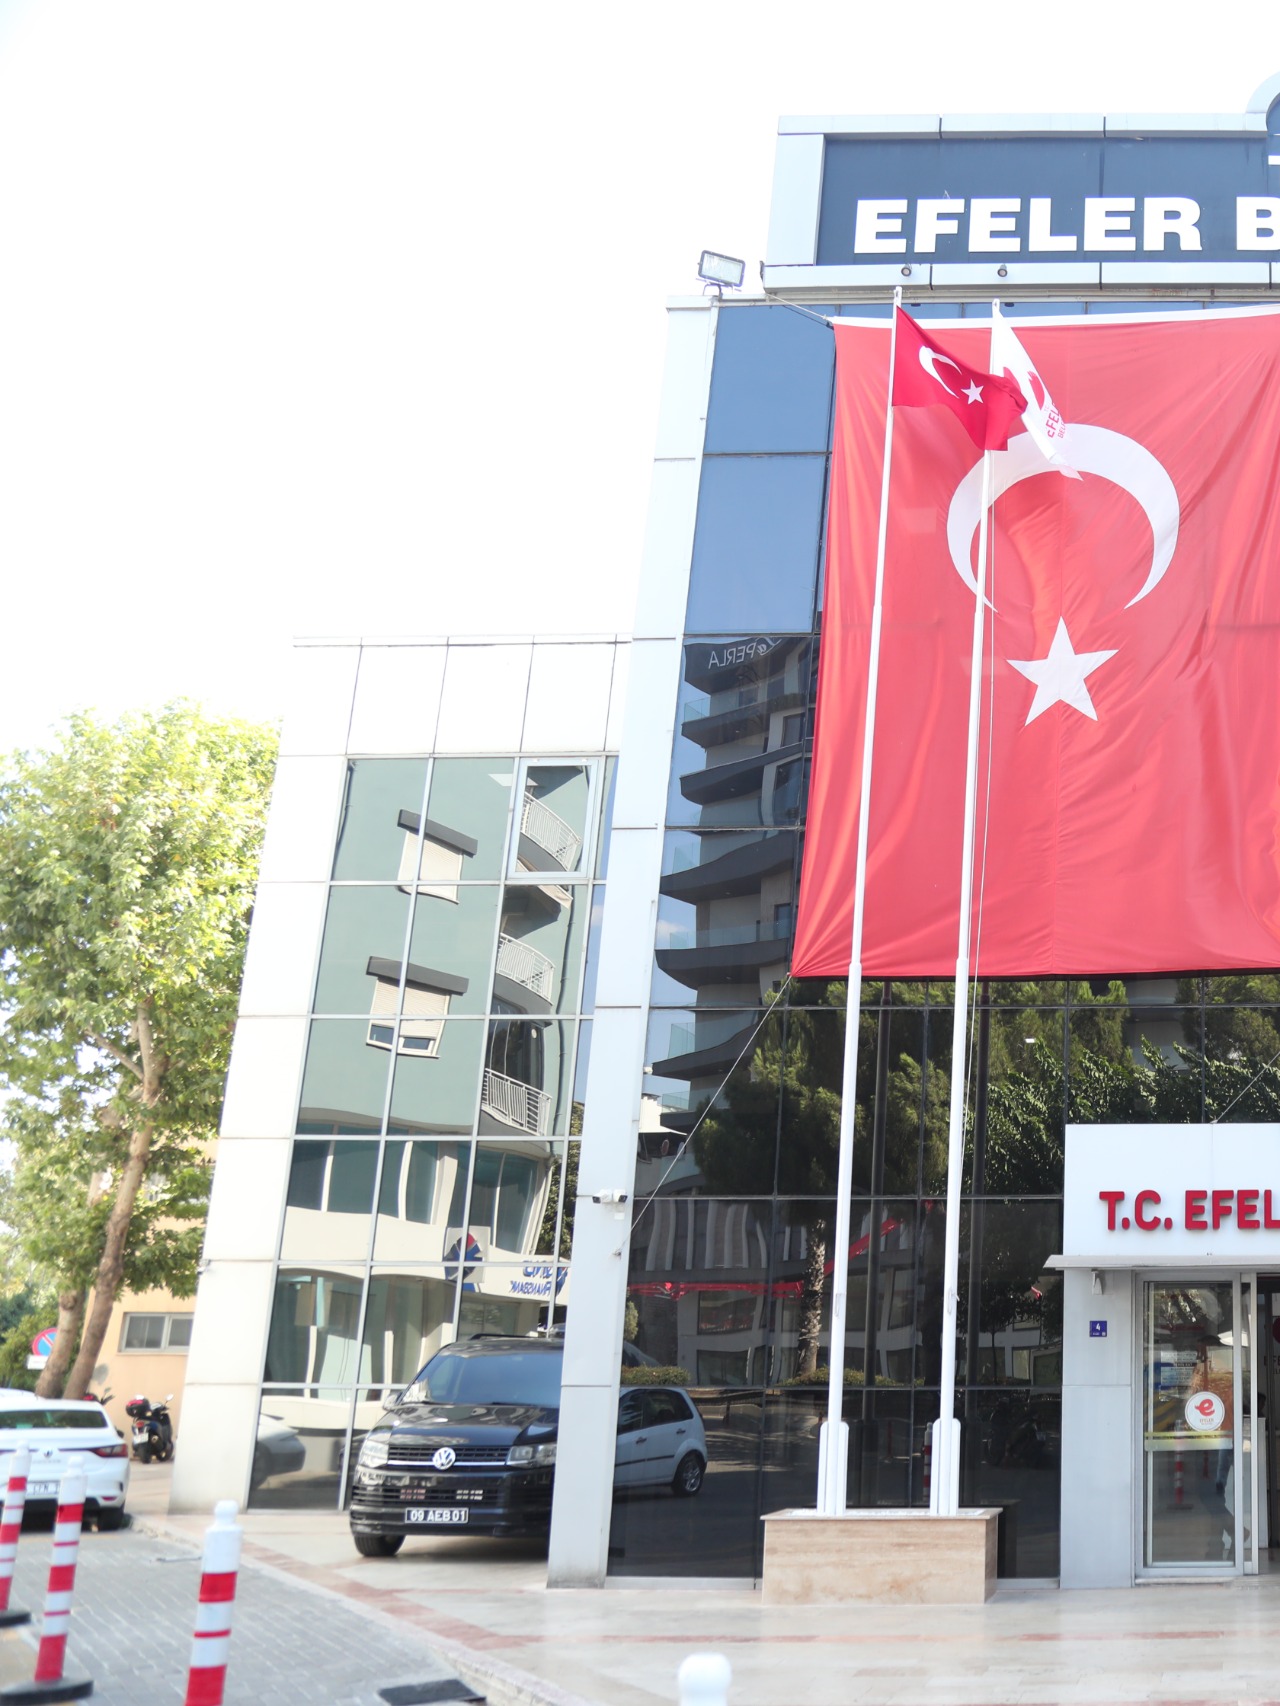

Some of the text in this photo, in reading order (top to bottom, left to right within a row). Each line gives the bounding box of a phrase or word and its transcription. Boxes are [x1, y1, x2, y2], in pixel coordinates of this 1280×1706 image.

[853, 196, 1203, 254] EFELER
[1099, 1190, 1173, 1232] T.C.
[410, 1509, 466, 1522] 09 AEB 01
